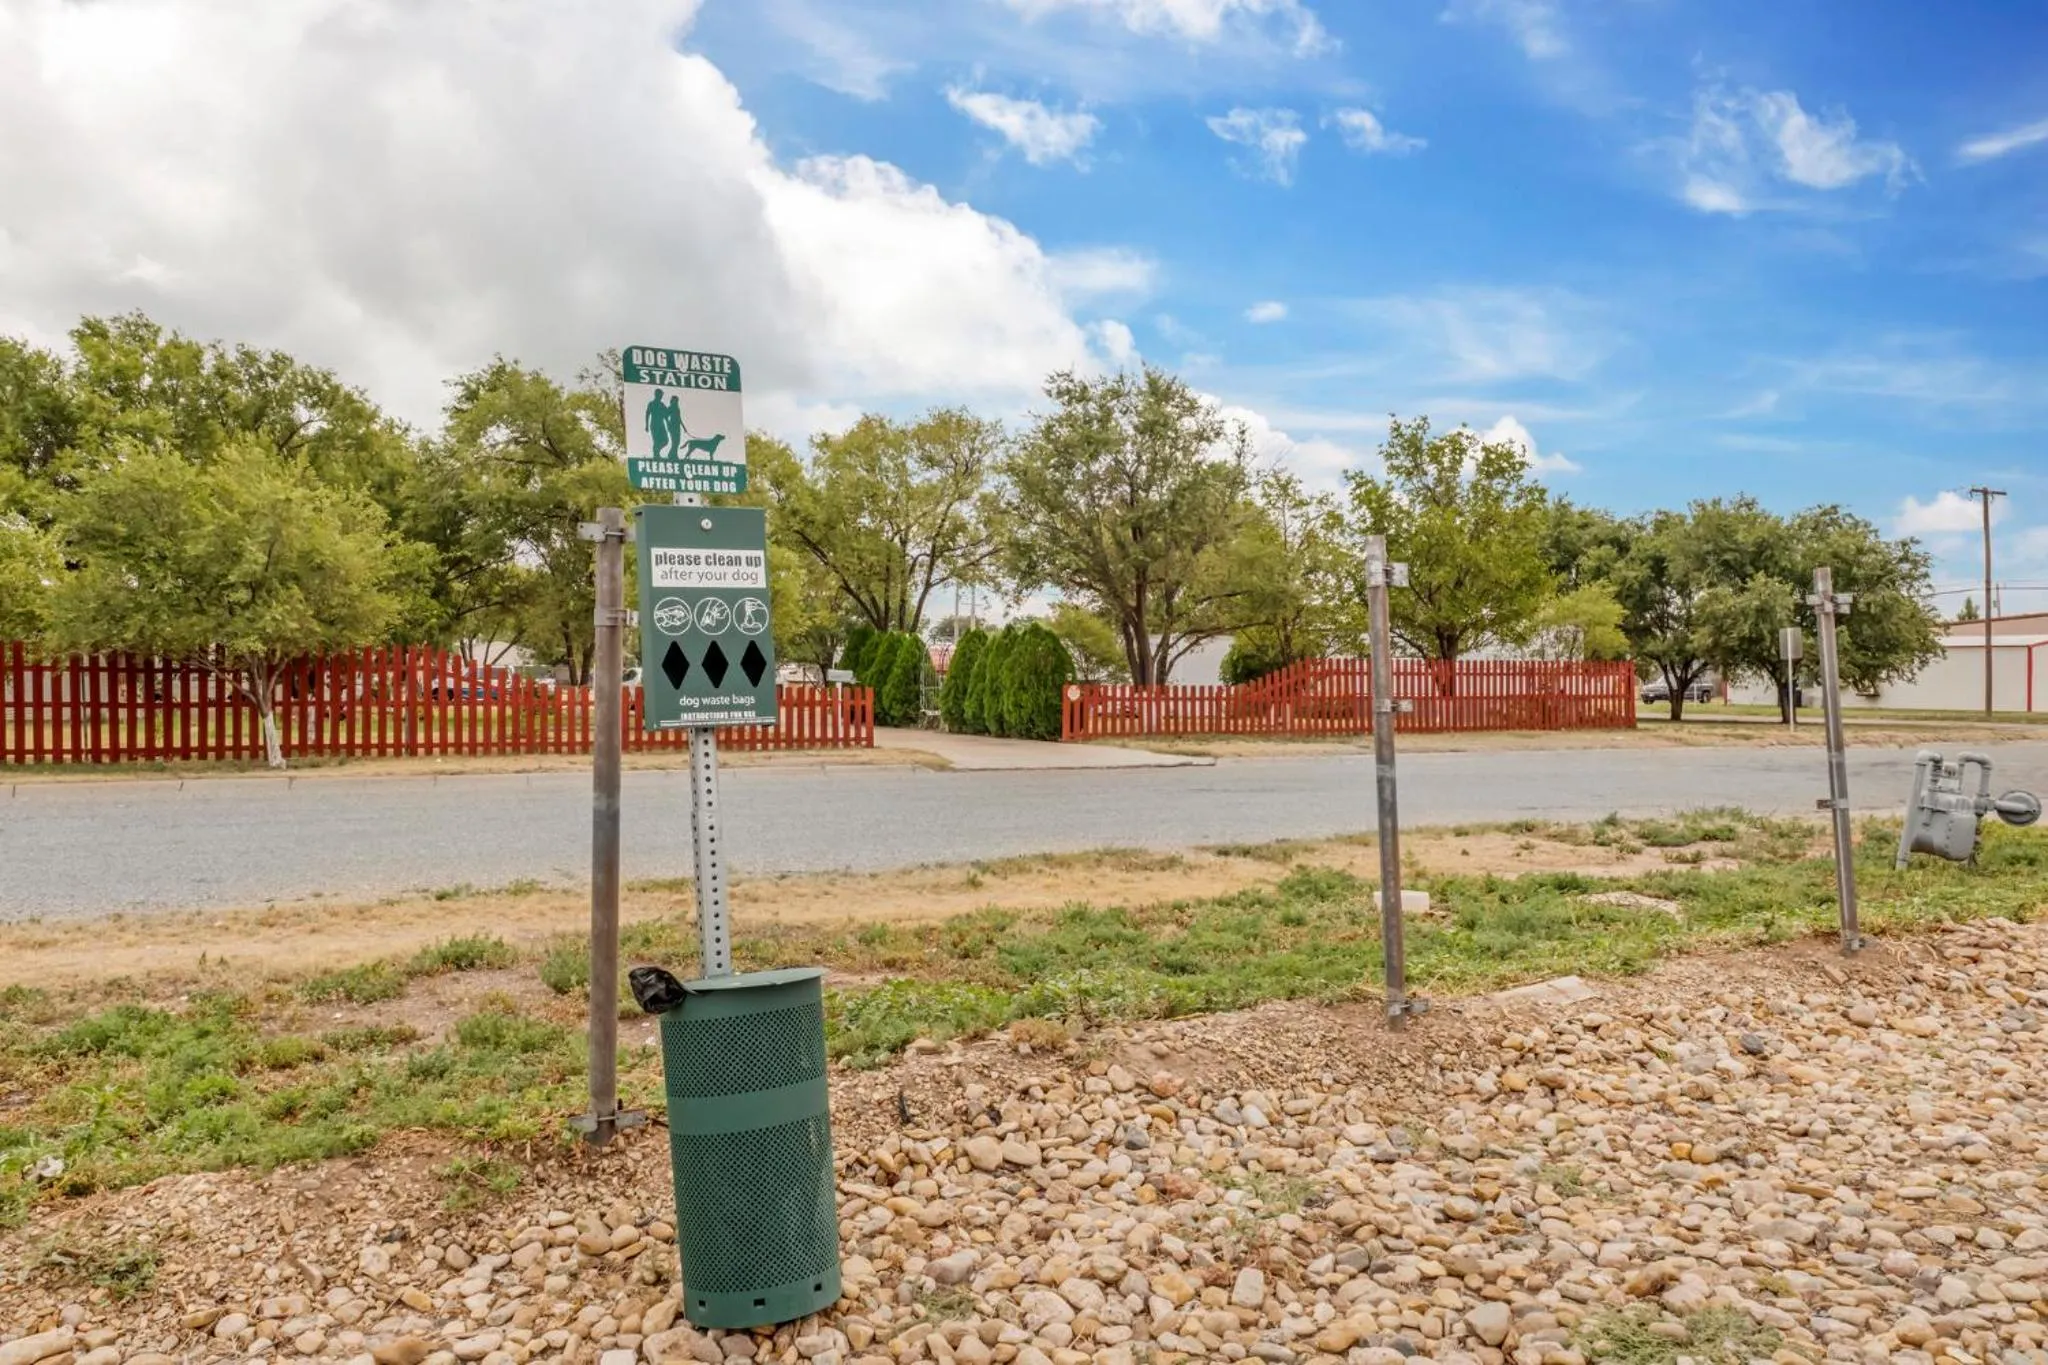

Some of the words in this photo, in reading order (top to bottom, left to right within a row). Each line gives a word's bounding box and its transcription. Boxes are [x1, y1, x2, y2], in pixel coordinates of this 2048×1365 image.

[631, 348, 667, 368] DOG
[673, 352, 732, 374] WASTE
[639, 369, 727, 390] STATION
[638, 460, 680, 474] PLEASE
[683, 463, 718, 476] CLEAN
[722, 465, 737, 477] UP
[641, 477, 676, 489] AFTER
[679, 478, 710, 491] YOUR
[713, 481, 736, 492] DOG
[655, 551, 701, 566] please
[705, 553, 742, 567] clean
[745, 556, 762, 568] up
[660, 567, 693, 580] after
[697, 571, 728, 583] your
[731, 569, 759, 584] dog
[680, 695, 700, 708] dog
[701, 696, 730, 705] waste
[732, 694, 755, 706] bags
